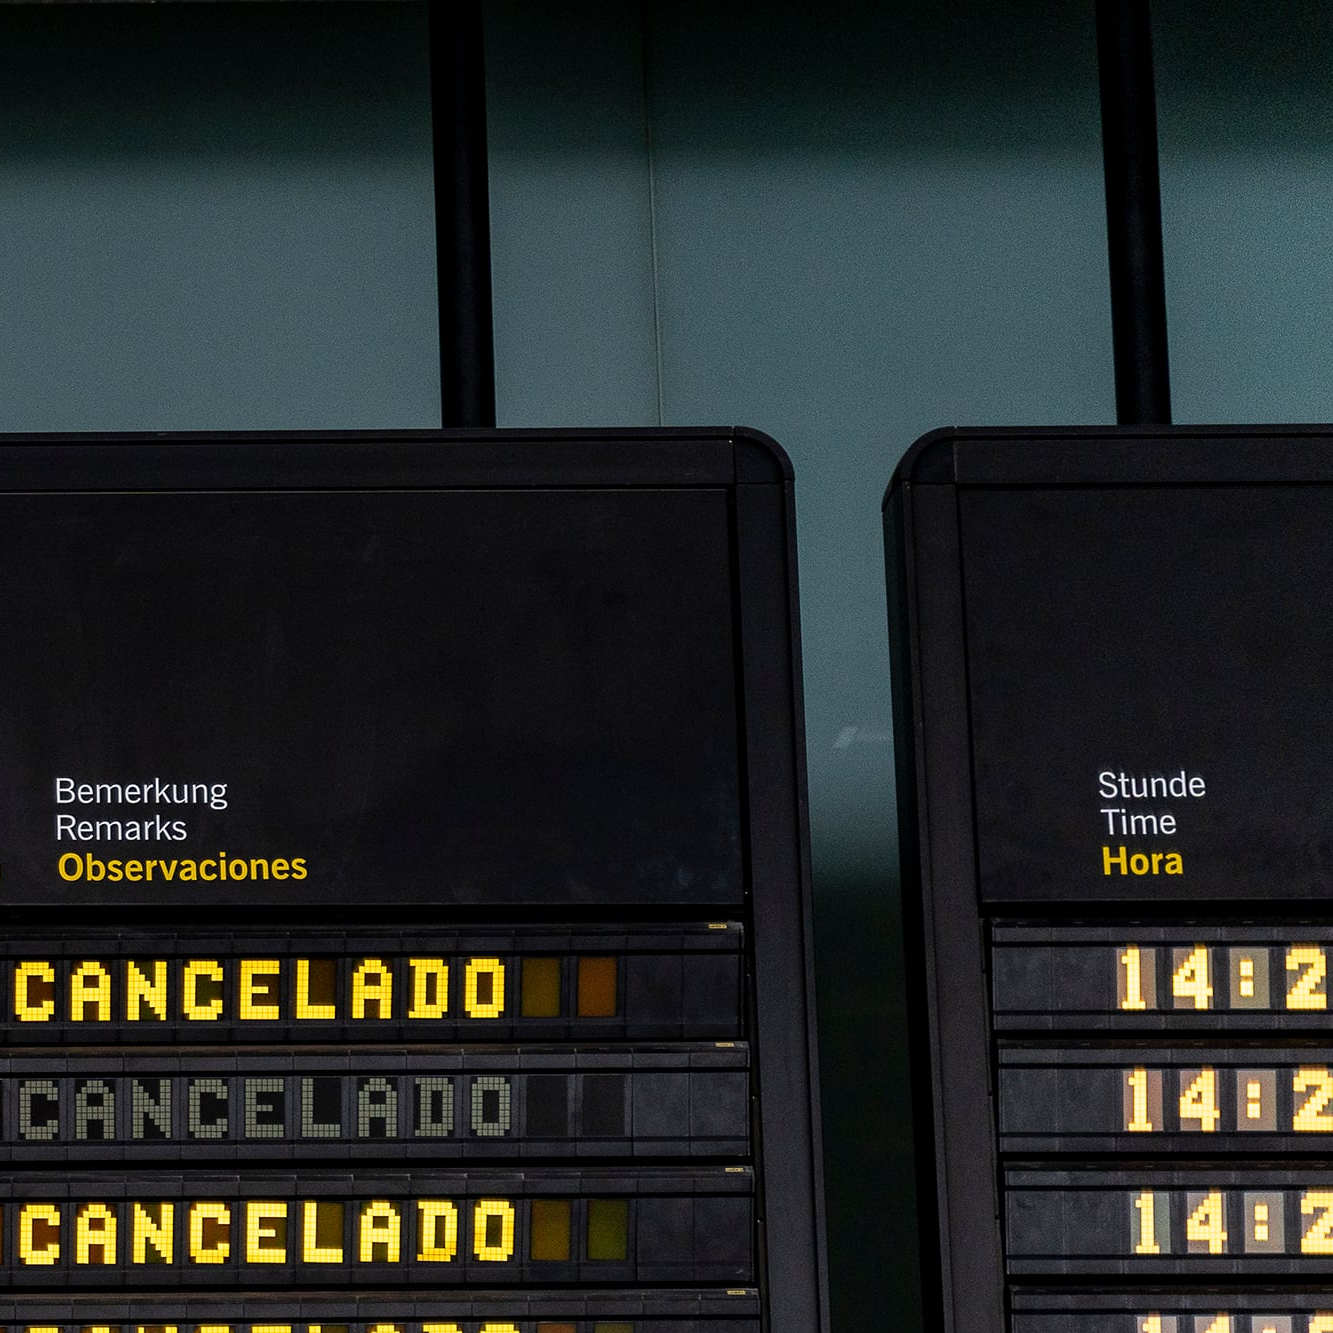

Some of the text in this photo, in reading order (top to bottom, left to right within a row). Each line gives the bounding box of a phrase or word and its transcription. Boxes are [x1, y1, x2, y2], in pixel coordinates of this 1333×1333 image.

[56, 778, 227, 809] Bemerkung
[1099, 771, 1205, 798] Stunde
[57, 815, 187, 840] Remarks
[1100, 809, 1176, 835] Time
[59, 852, 307, 881] Observaciones
[1103, 846, 1183, 875] Hora
[15, 958, 505, 1022] CANCELADO
[1117, 946, 1327, 1010] 14:2
[18, 1076, 511, 1140] CANCELADO
[1123, 1067, 1333, 1132] 14:2
[19, 1200, 515, 1265] CANCELADO
[1134, 1189, 1333, 1255] 14:2
